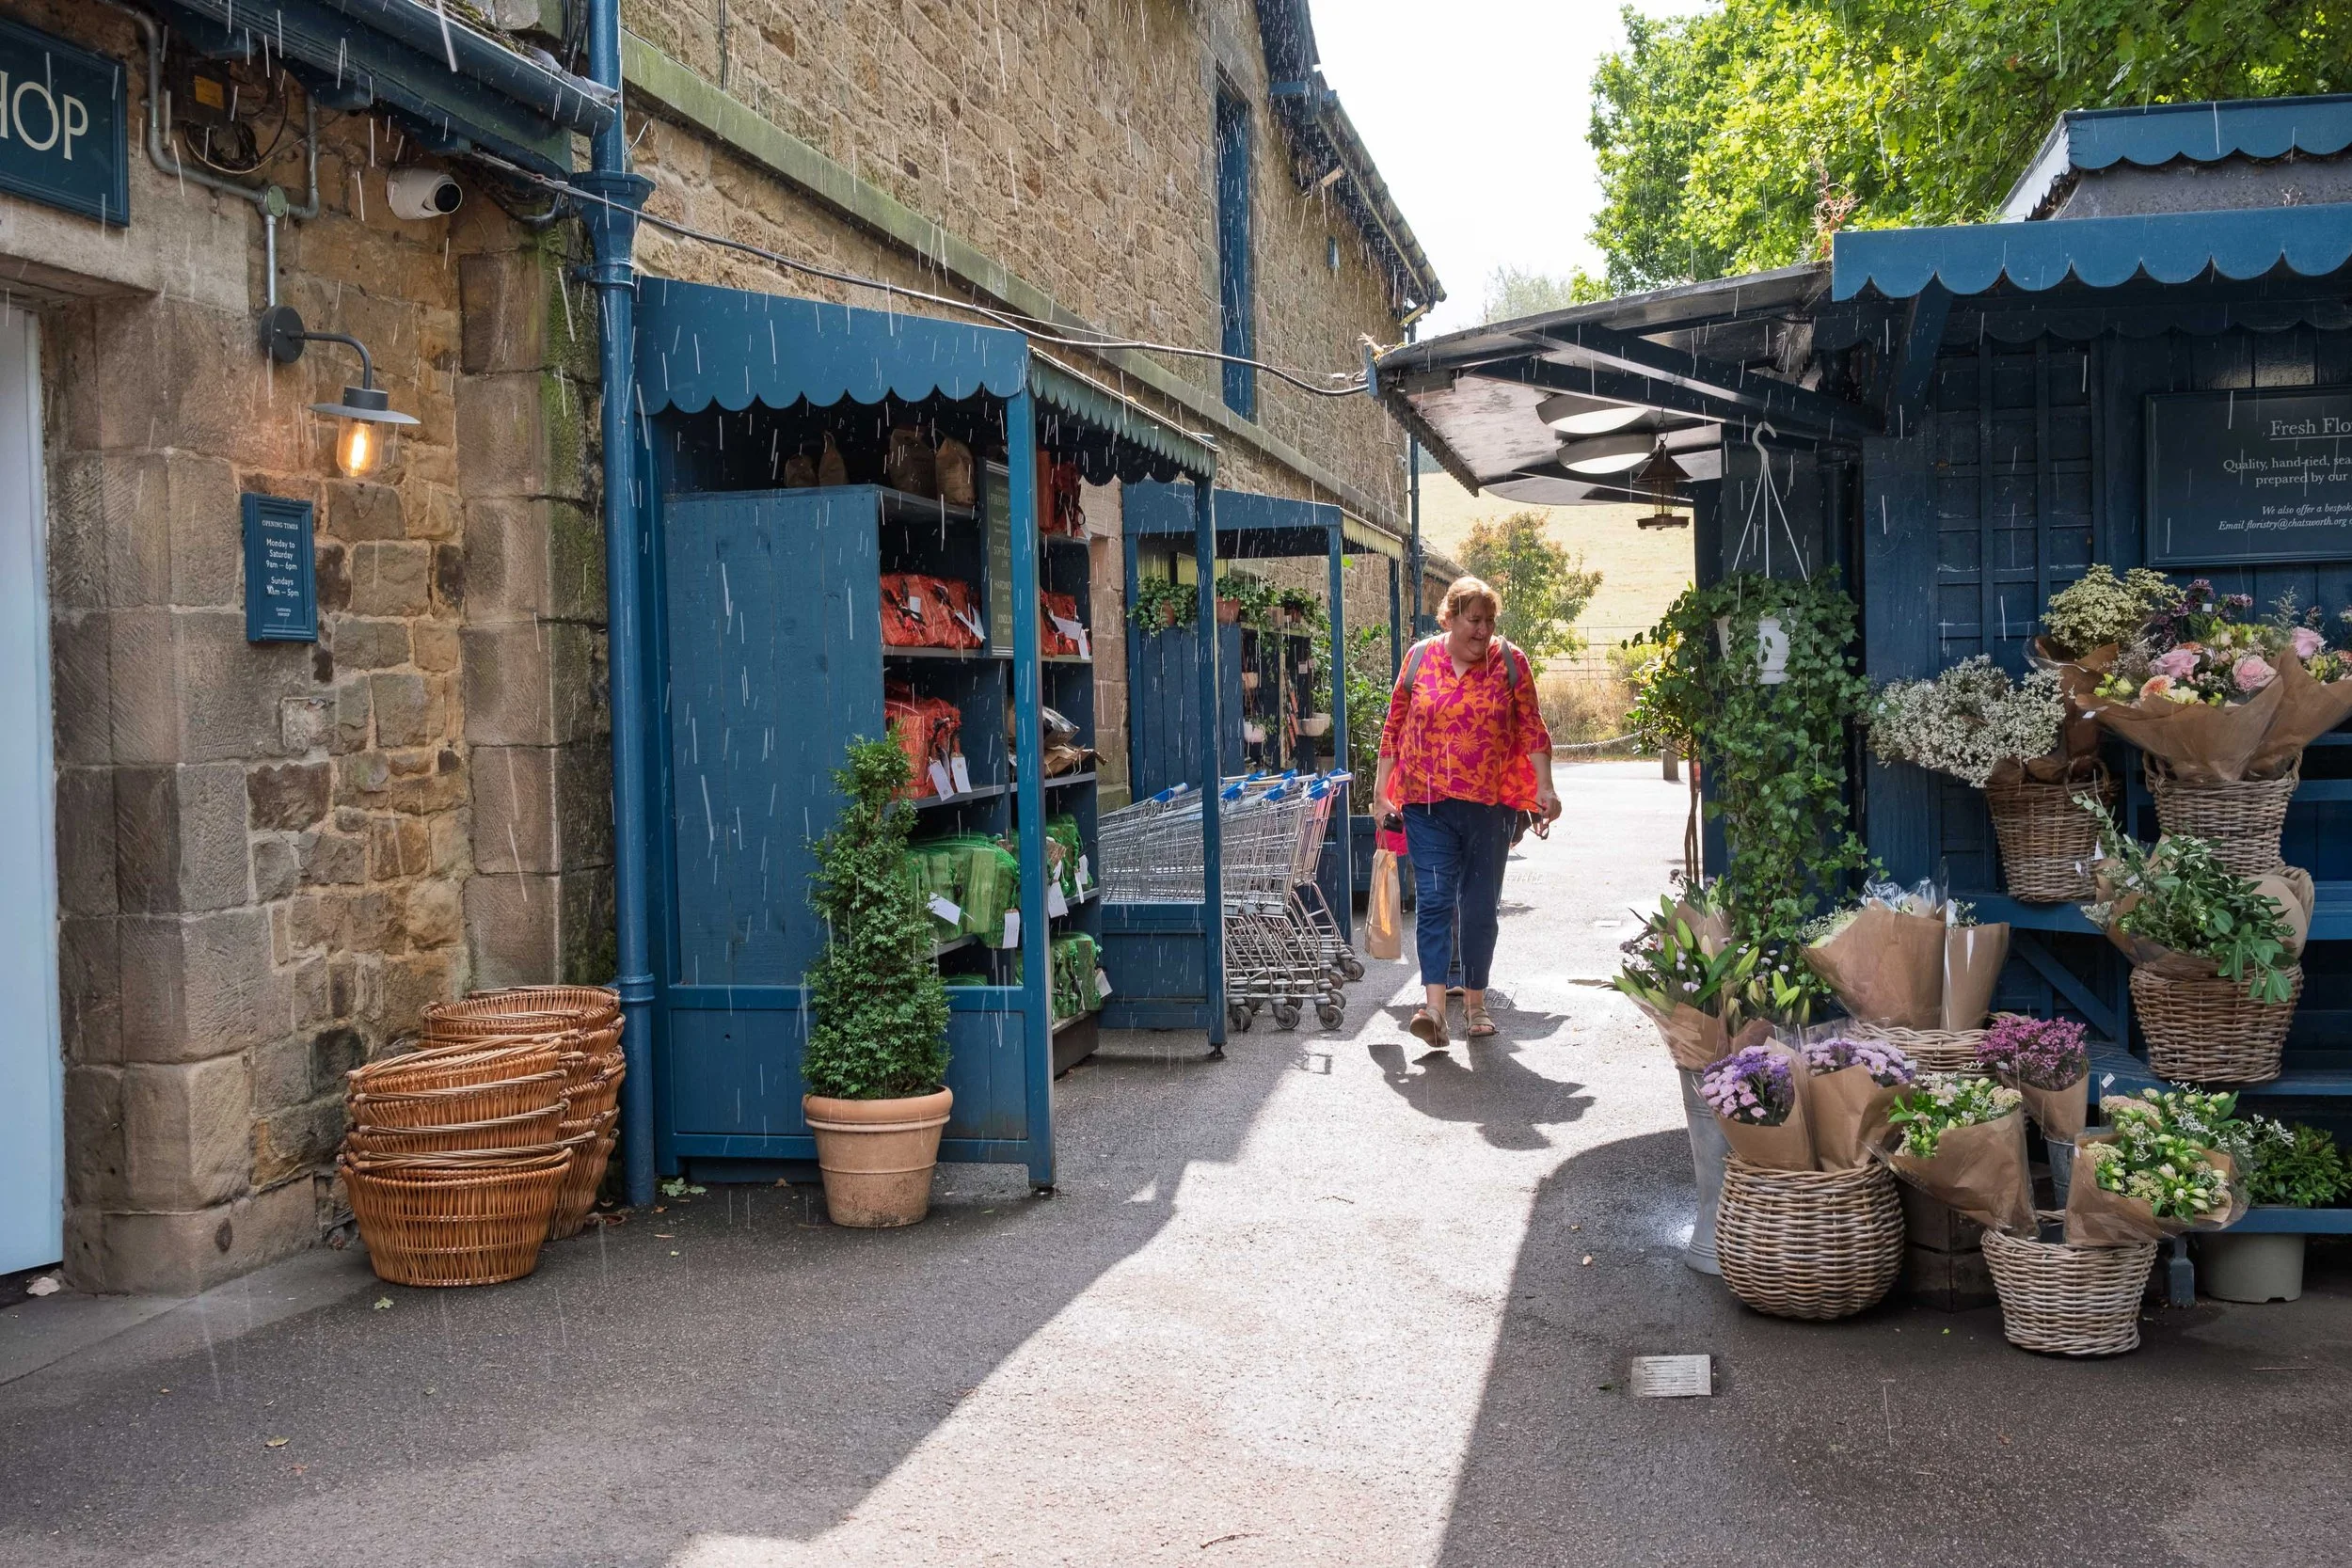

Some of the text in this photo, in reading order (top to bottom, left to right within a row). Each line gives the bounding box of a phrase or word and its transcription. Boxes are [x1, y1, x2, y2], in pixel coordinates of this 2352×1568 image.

[0, 70, 88, 161] OP
[2270, 417, 2352, 436] Fresh Flo
[2223, 454, 2352, 473] Quality, hand-tied, sea
[2256, 471, 2348, 487] prepared by our
[2262, 505, 2276, 515] We
[2278, 505, 2294, 515] also
[2296, 503, 2314, 516] offer
[262, 519, 298, 531] OPENING TIMES
[2218, 519, 2244, 531] Email
[2244, 516, 2347, 531] floristry@chatsworth.org
[266, 537, 295, 549] Monday to
[269, 549, 294, 561] Saturday
[265, 560, 278, 569] 9am
[285, 562, 298, 572] 6pm
[271, 576, 294, 587] Sundays
[287, 588, 300, 598] 5pm
